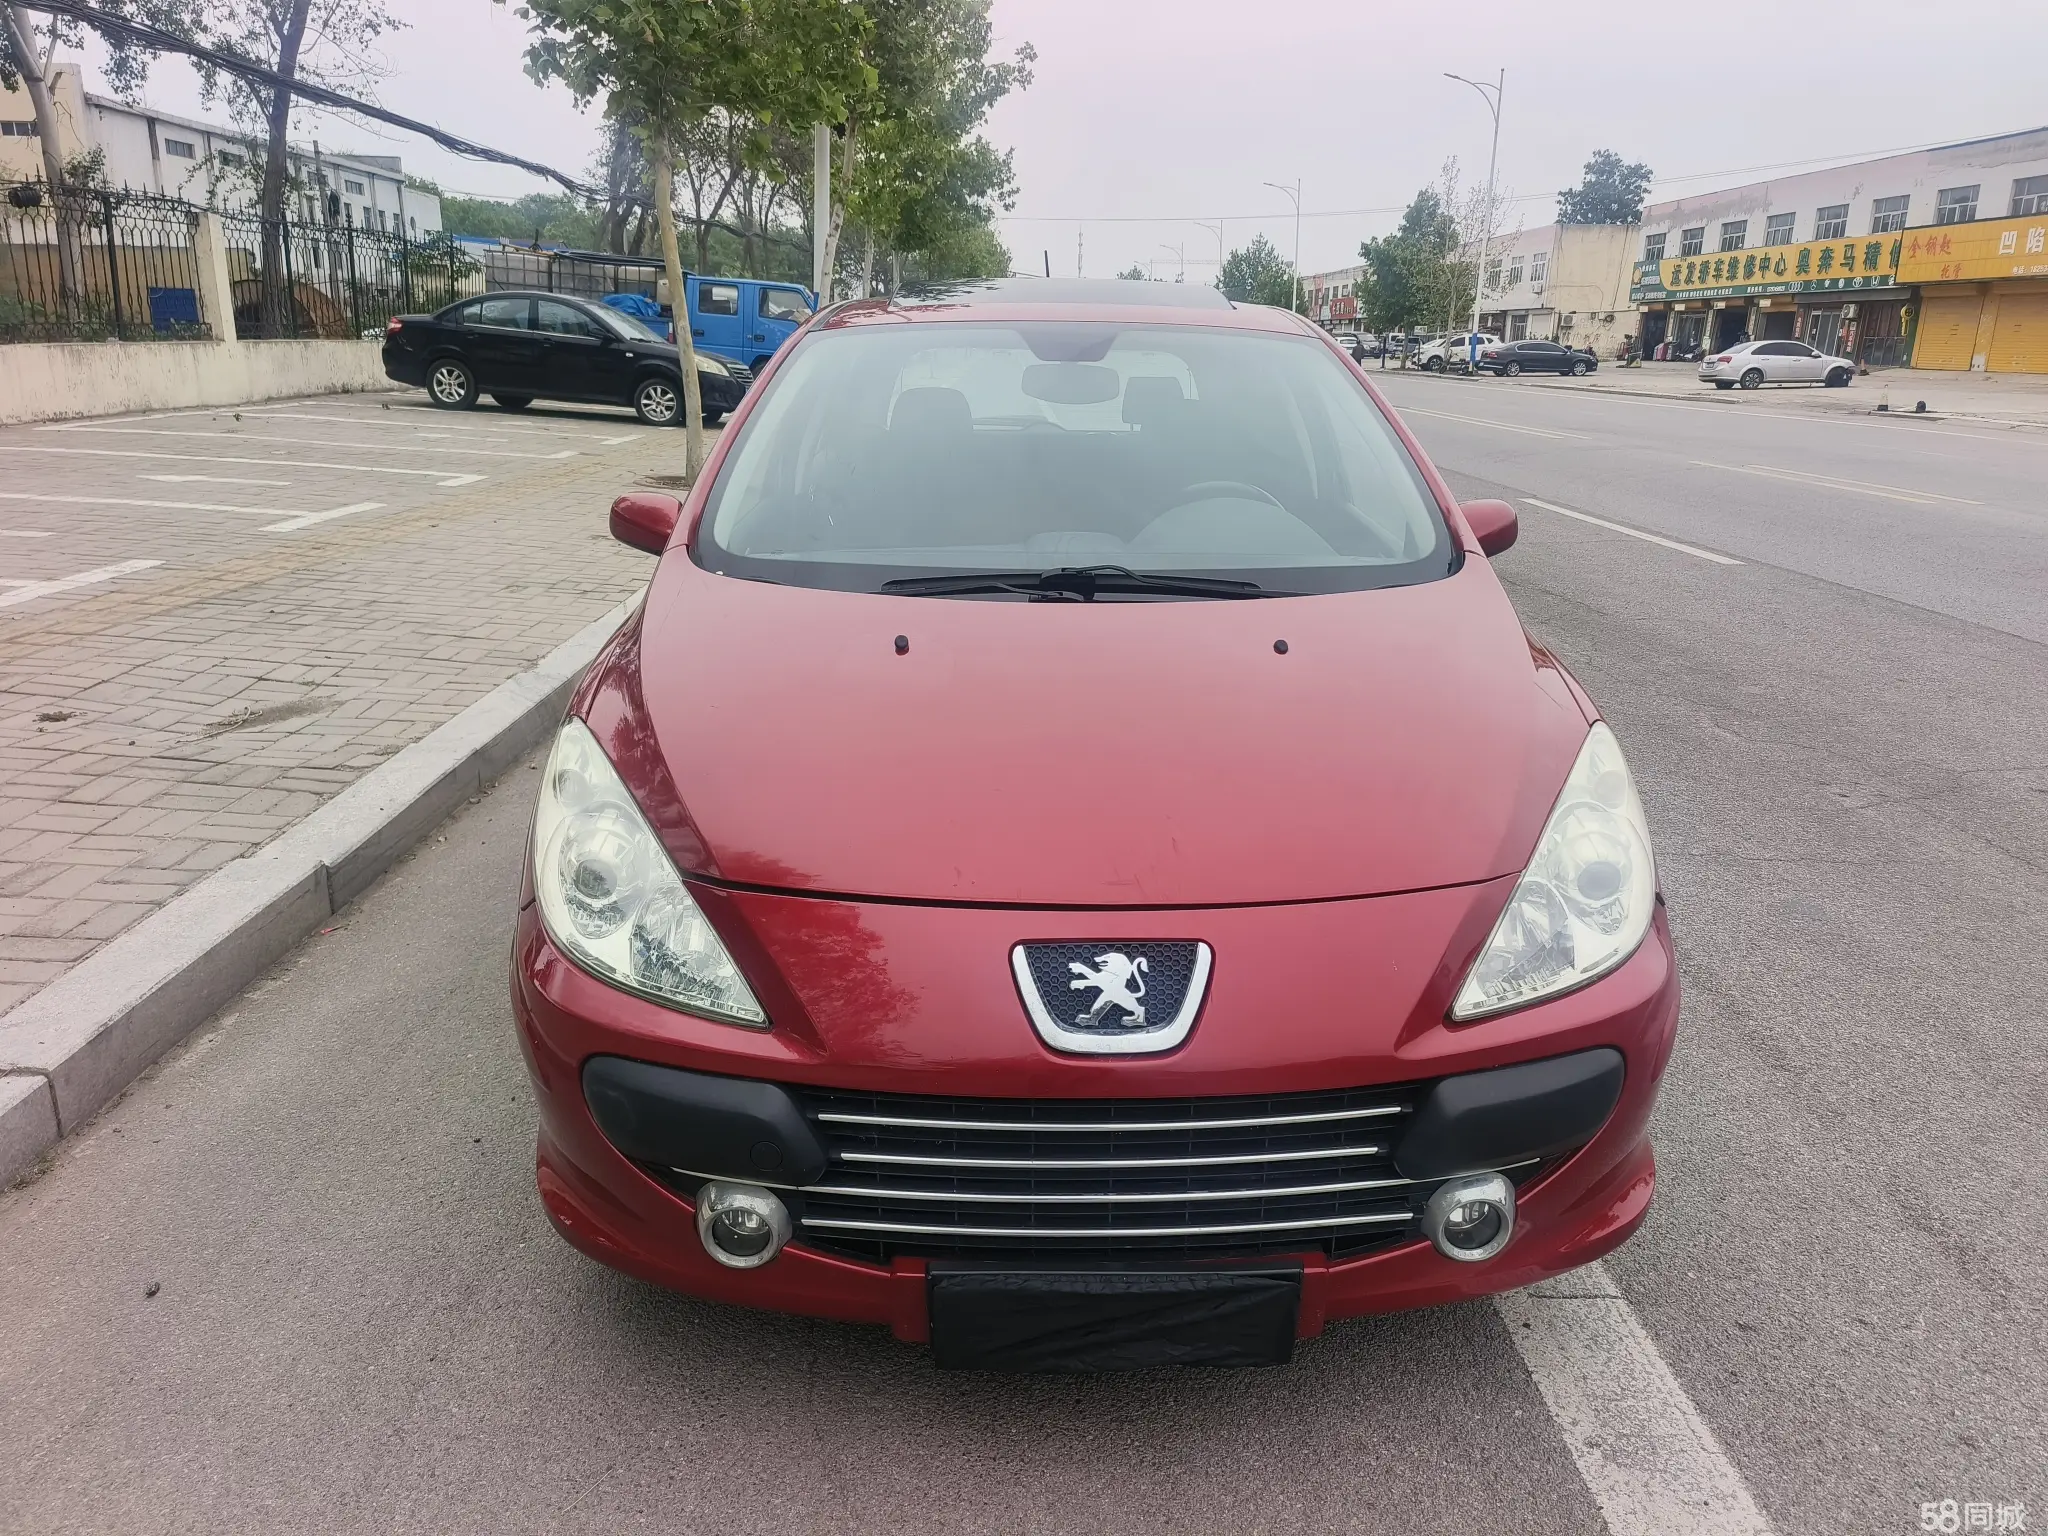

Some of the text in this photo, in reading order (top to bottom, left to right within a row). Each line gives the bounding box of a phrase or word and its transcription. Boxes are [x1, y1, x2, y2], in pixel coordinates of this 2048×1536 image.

[1908, 233, 1952, 259] 金钥匙
[1999, 227, 2046, 255] 凹陷
